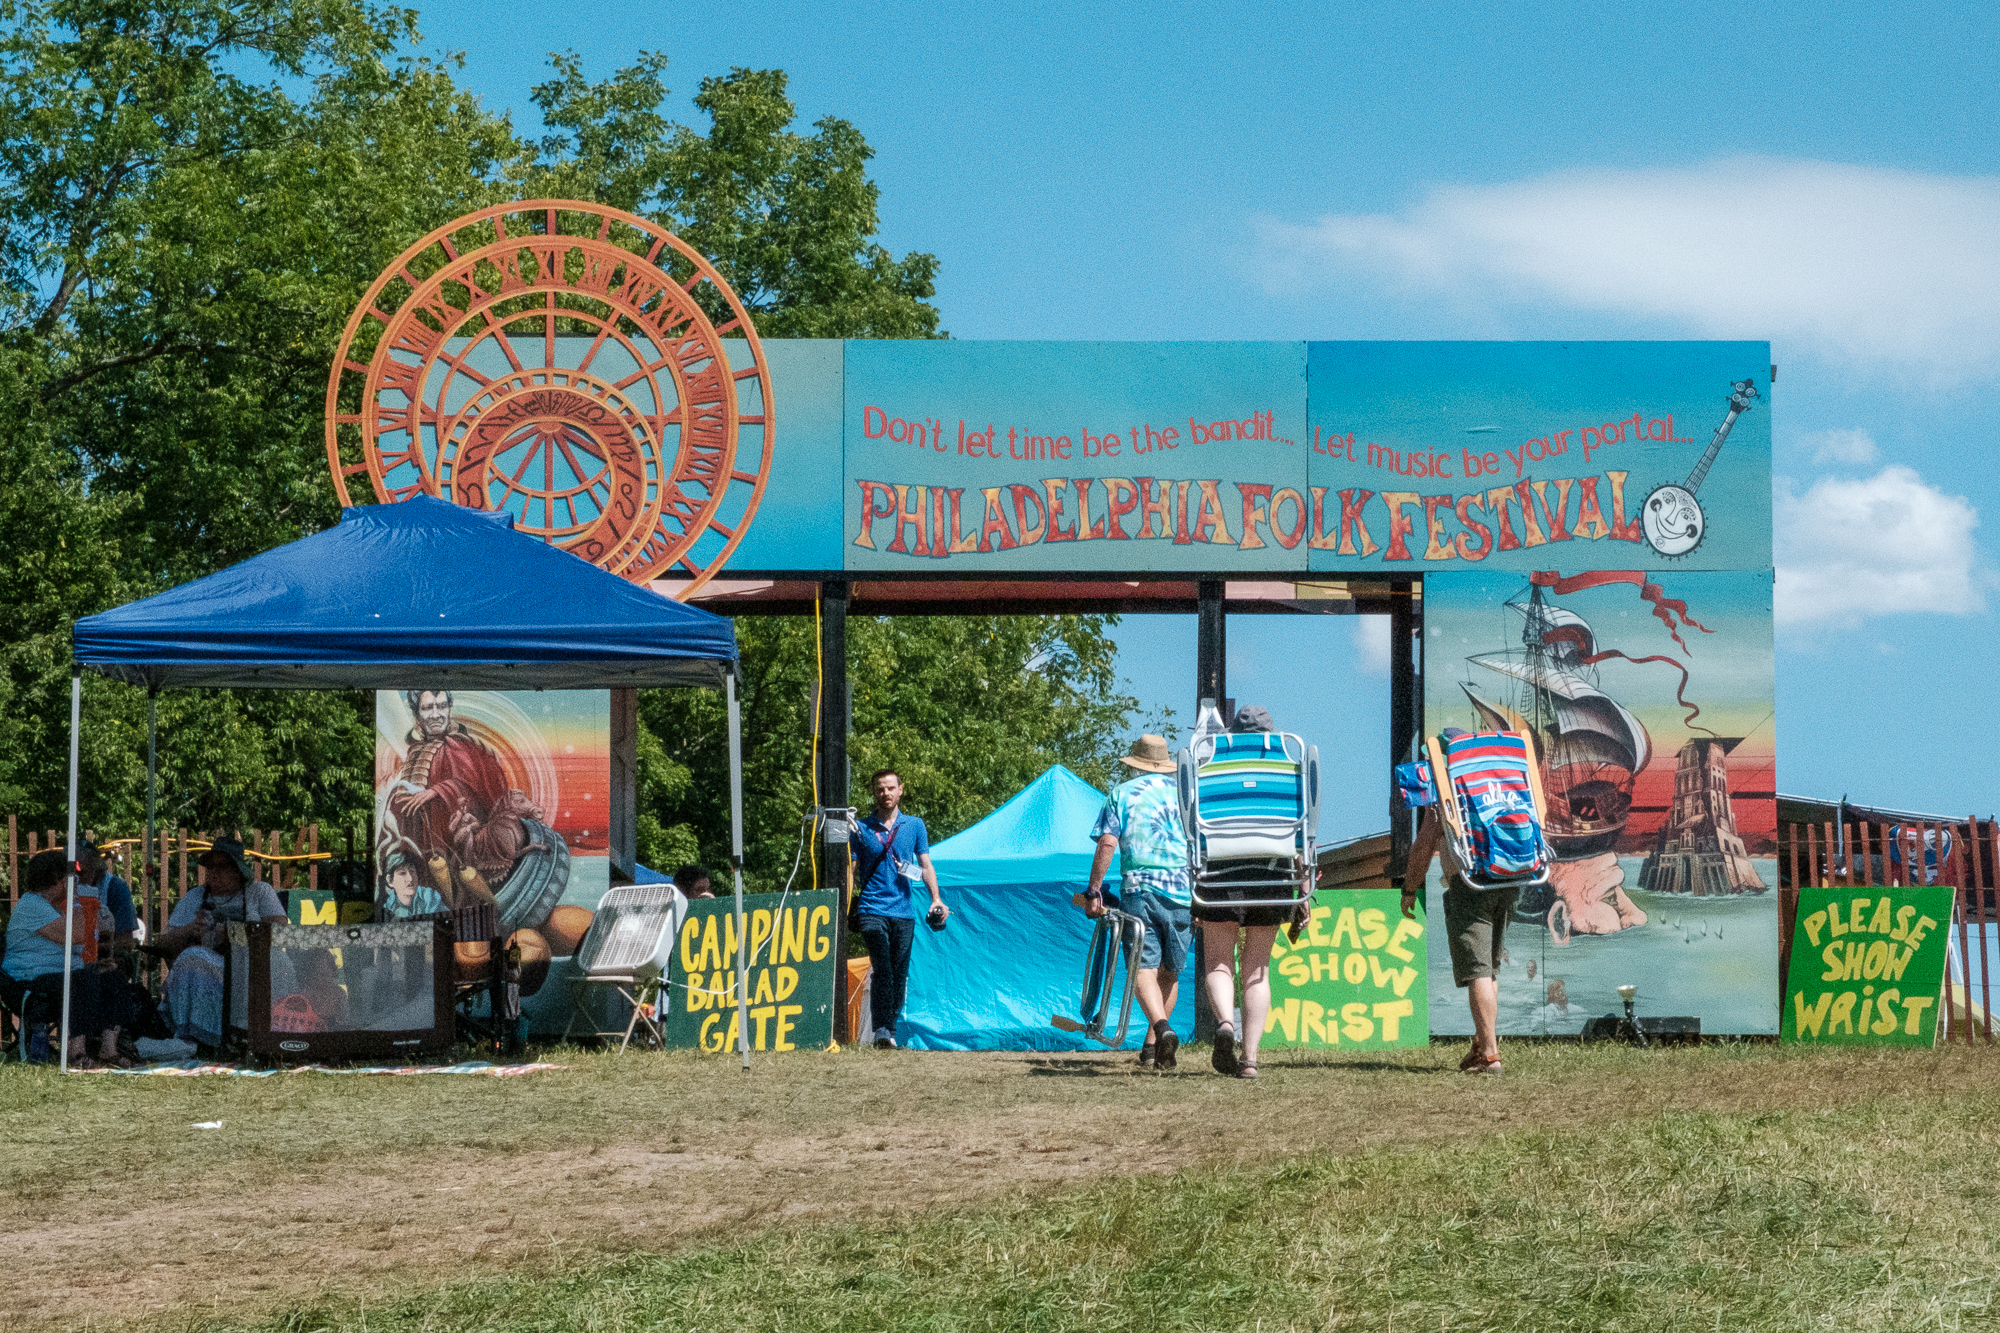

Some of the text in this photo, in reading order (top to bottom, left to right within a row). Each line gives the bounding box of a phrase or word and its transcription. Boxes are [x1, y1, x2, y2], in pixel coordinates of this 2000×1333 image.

[863, 405, 948, 452] Don't
[957, 420, 1002, 460] let
[1007, 426, 1072, 461] time
[1082, 427, 1121, 460] be
[1132, 423, 1180, 455] the
[1313, 425, 1357, 462] Let
[1367, 442, 1452, 479] music
[1463, 447, 1501, 478] be
[1504, 428, 1574, 478] your
[853, 470, 1645, 562] PHILADELPHIA FOLK FESTIVAL
[680, 905, 830, 973] CAMPING
[1803, 897, 1937, 951] PLEASE
[1278, 953, 1418, 997] SHOW
[1821, 940, 1913, 982] SHOW
[686, 966, 799, 1012] BALLAD
